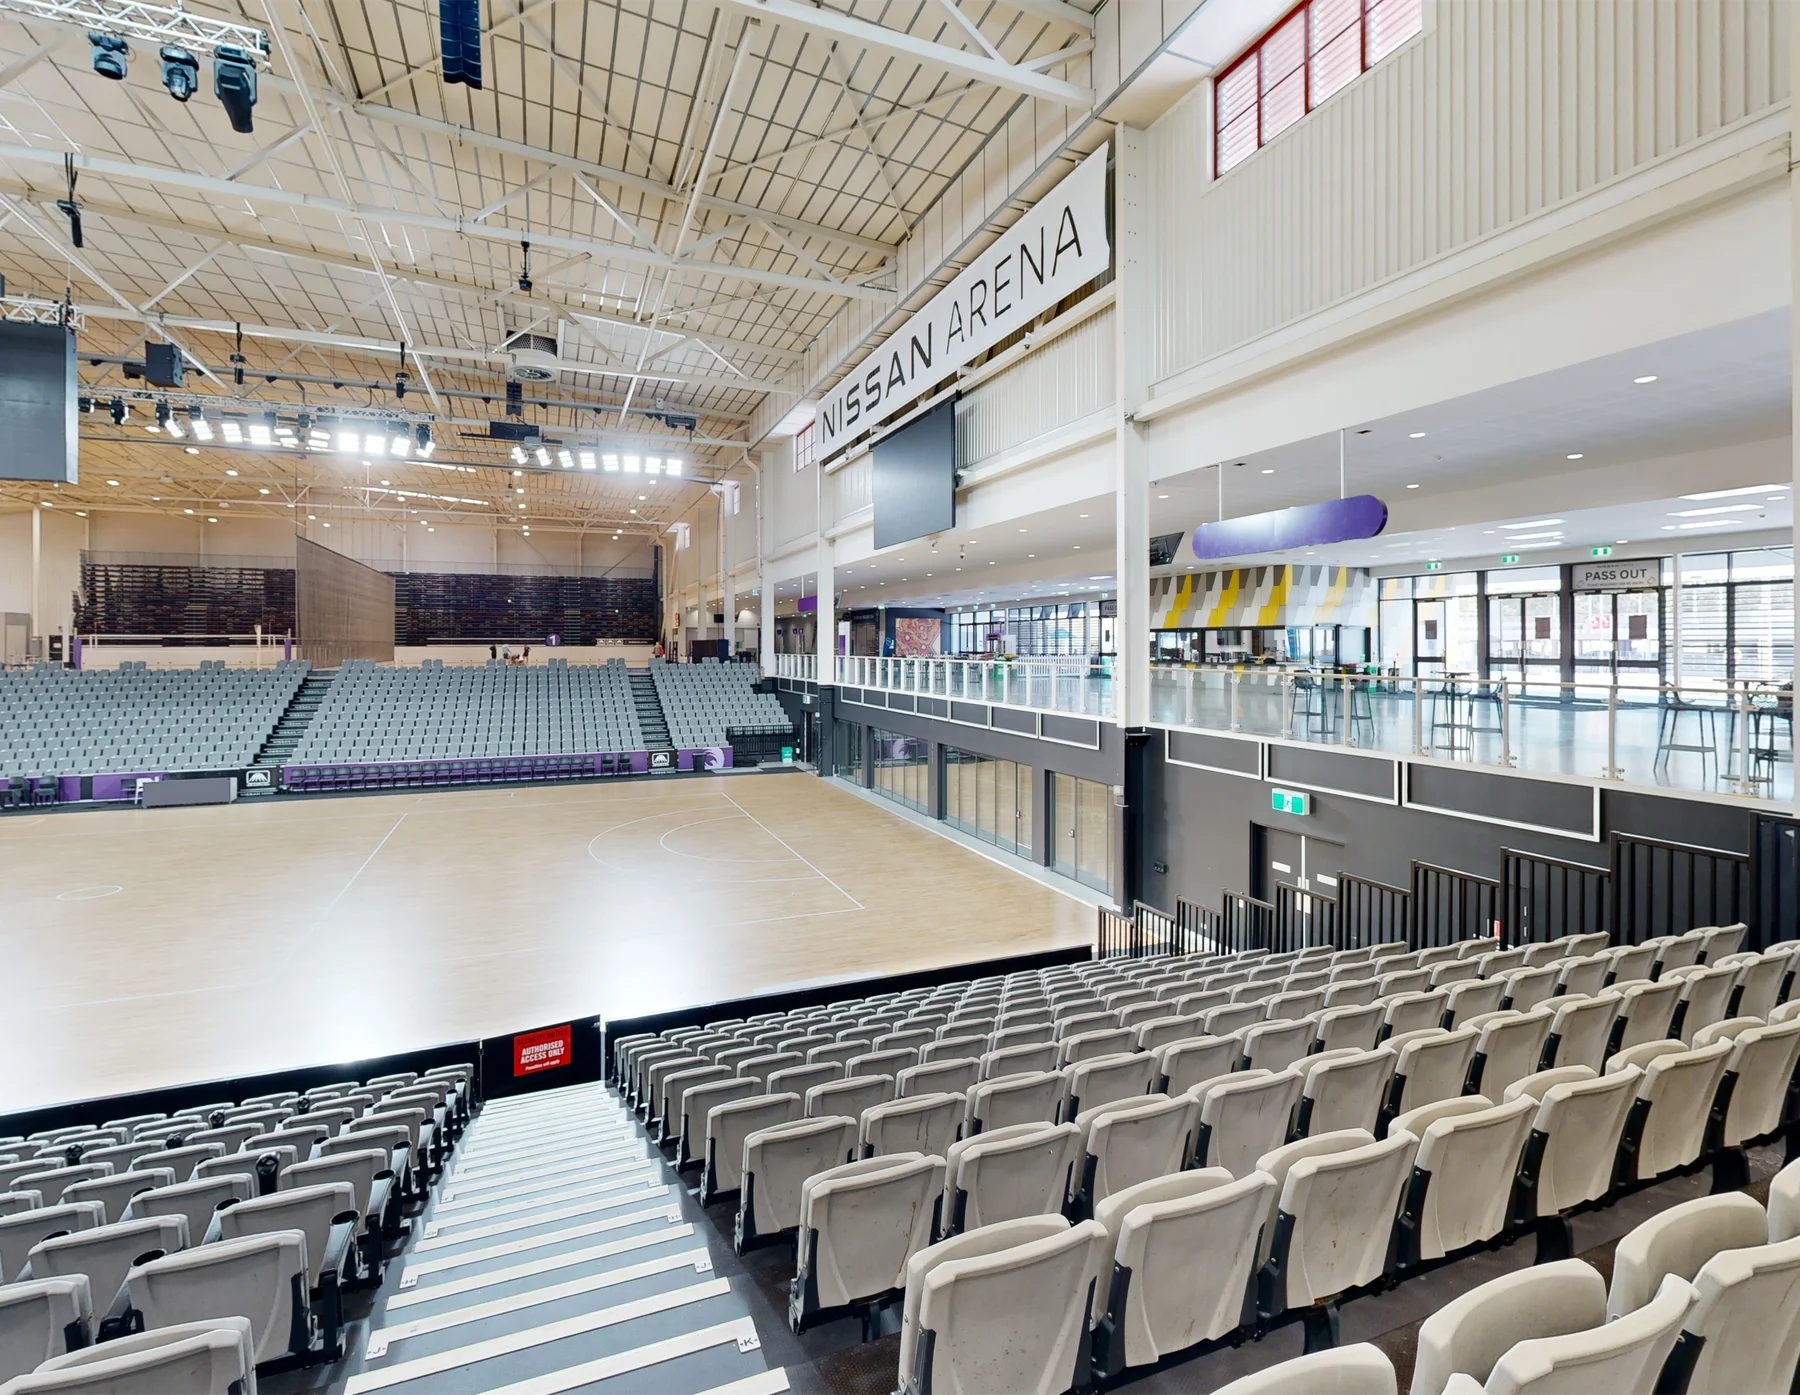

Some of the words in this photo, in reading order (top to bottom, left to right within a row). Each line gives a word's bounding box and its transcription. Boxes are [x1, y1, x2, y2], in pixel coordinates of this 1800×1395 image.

[822, 321, 932, 443] NISSAN
[946, 204, 1082, 354] ARENA
[1585, 571, 1616, 581] PASS
[1620, 569, 1647, 579] OUT
[549, 635, 556, 645] 1
[521, 1040, 563, 1056] AUTHORISED
[520, 1052, 546, 1064] ACCESS
[548, 1047, 565, 1057] ONLY
[744, 1337, 753, 1346] K
[373, 1346, 381, 1354] J
